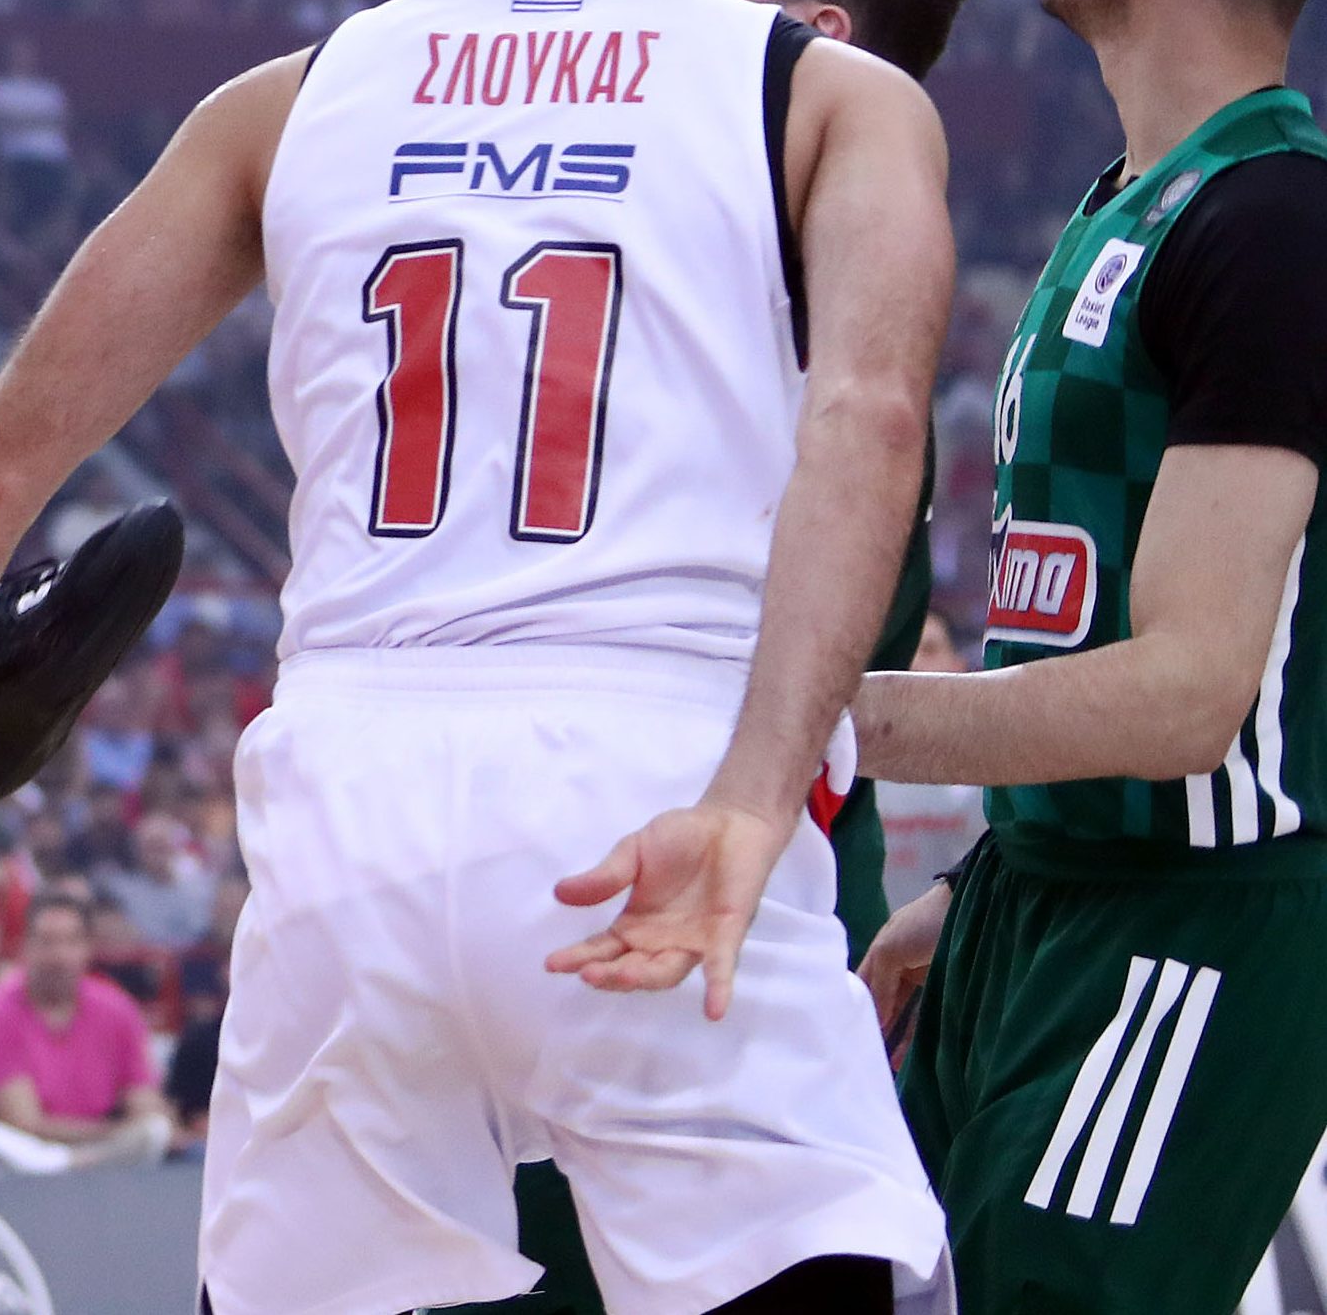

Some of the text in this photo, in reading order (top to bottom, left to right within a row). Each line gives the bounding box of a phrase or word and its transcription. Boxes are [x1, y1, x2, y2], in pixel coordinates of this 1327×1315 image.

[413, 31, 660, 106] ΣΛΟΥΚΑΣ
[389, 142, 636, 196] FMS
[363, 237, 622, 544] 11
